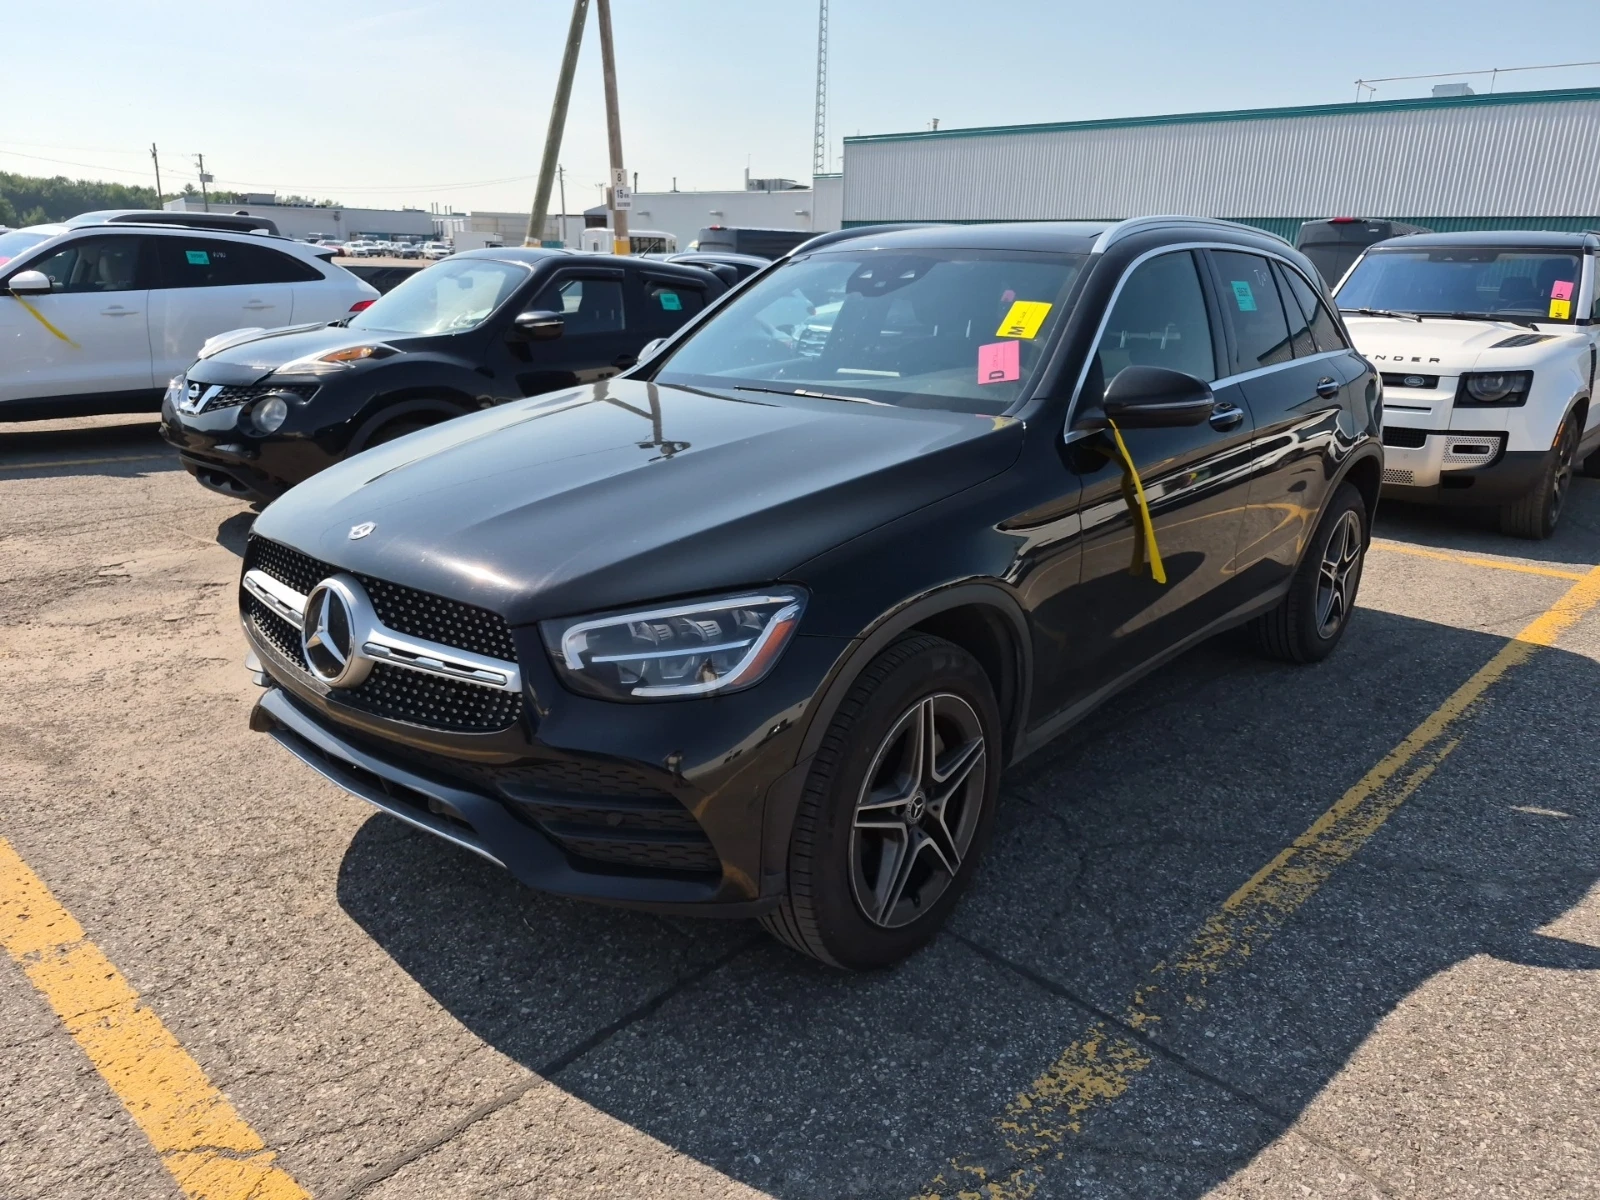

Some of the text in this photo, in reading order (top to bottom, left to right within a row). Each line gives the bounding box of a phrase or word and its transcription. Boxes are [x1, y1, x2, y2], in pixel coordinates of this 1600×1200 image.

[617, 172, 622, 182] 8
[616, 189, 623, 199] 15
[1007, 325, 1026, 336] M
[989, 370, 1004, 380] D
